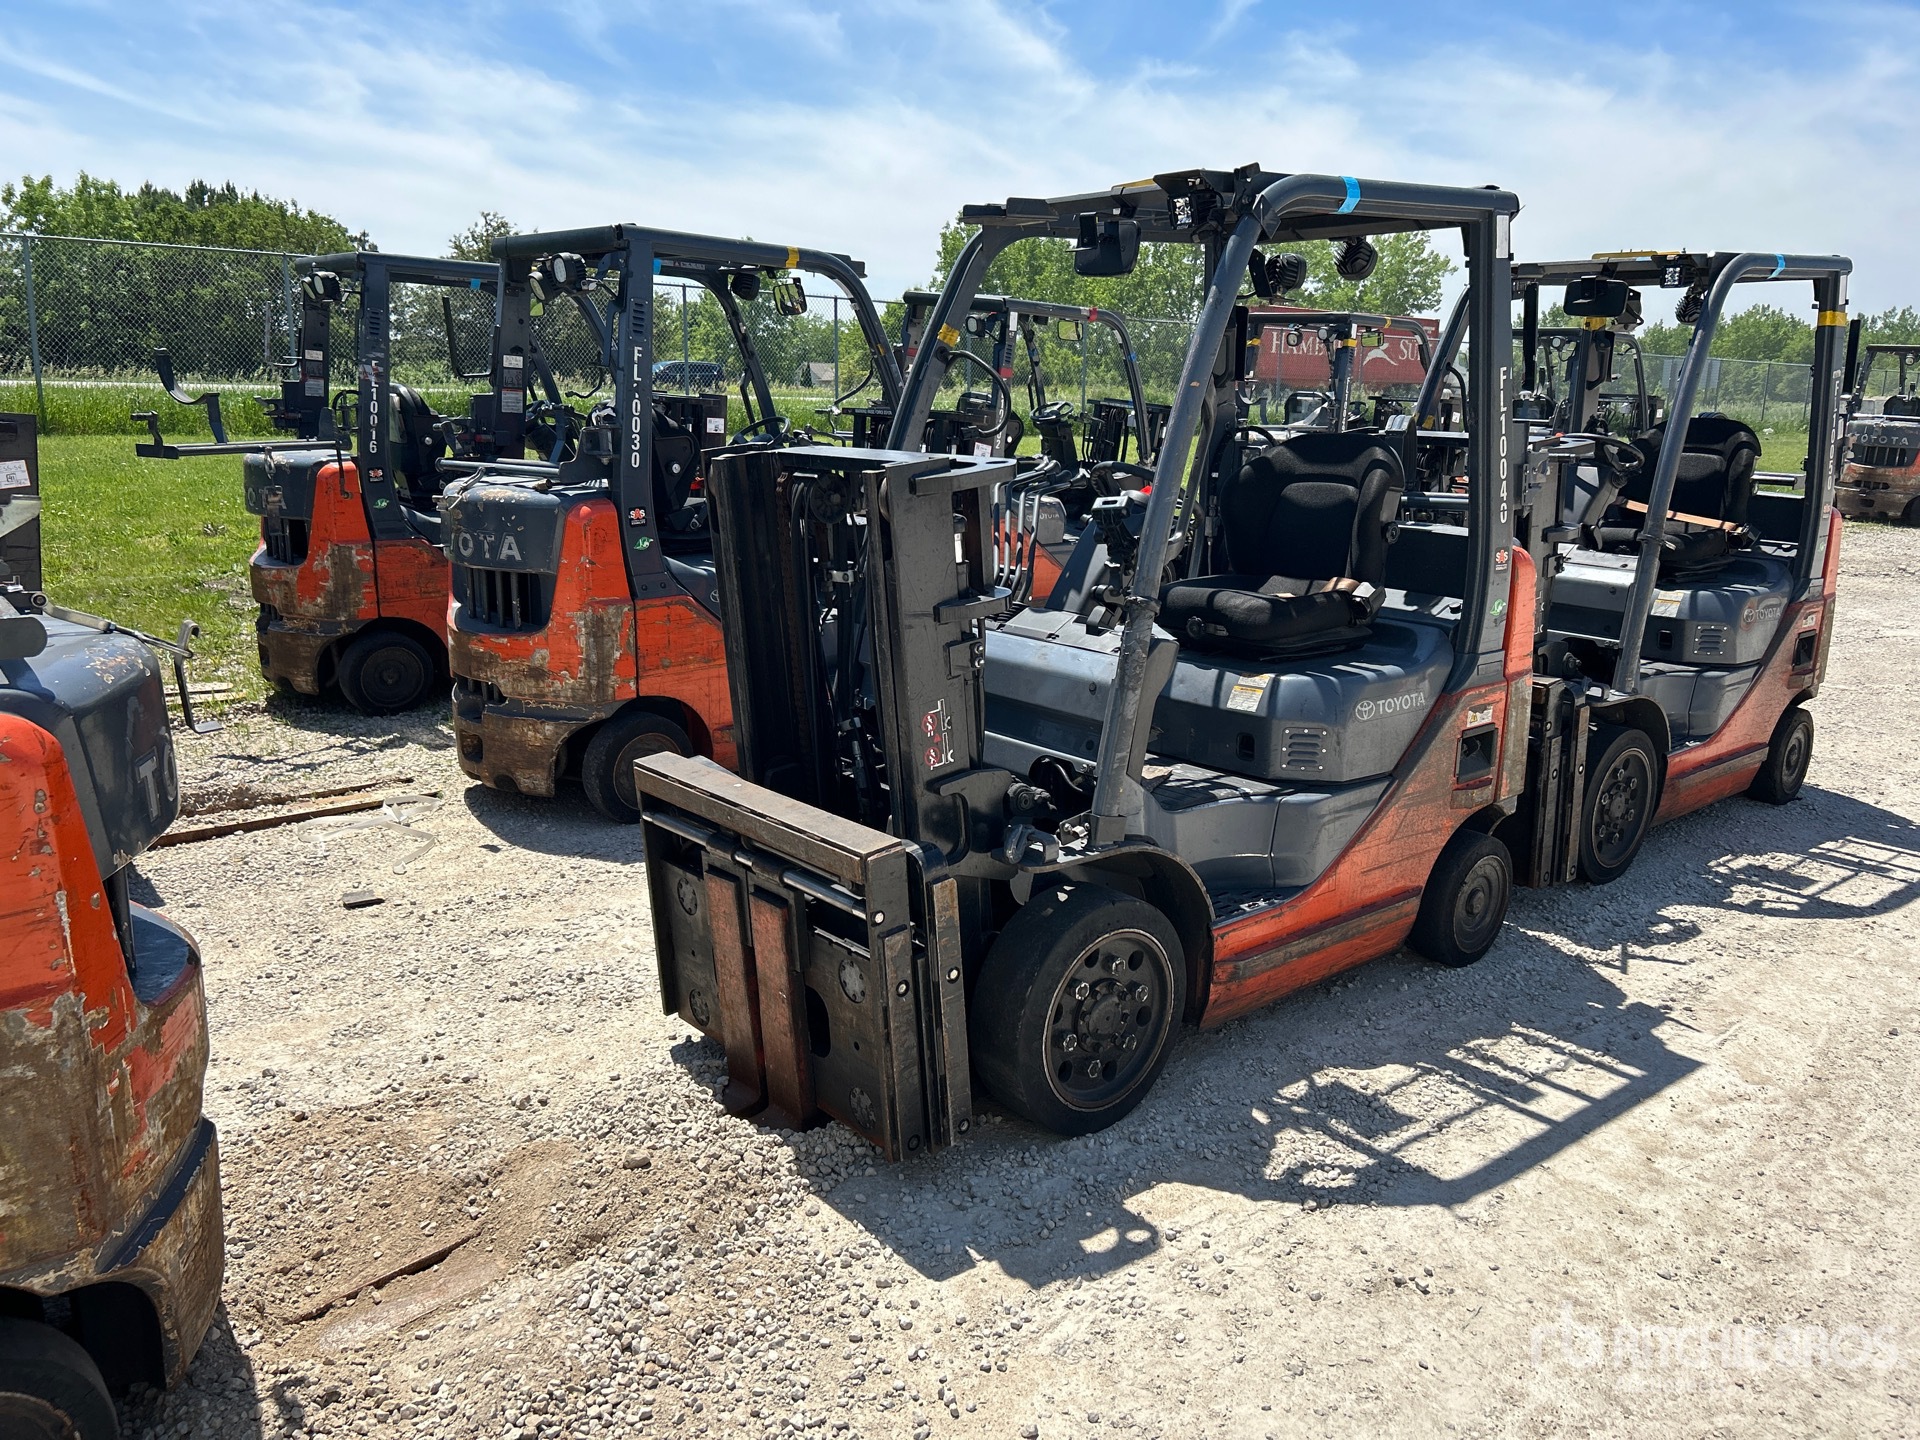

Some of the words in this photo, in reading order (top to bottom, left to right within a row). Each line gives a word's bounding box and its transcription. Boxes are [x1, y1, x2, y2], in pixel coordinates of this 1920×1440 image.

[1499, 366, 1508, 523] FL10040
[1755, 607, 1781, 620] TOYOTA
[1376, 692, 1426, 715] TOYOTA
